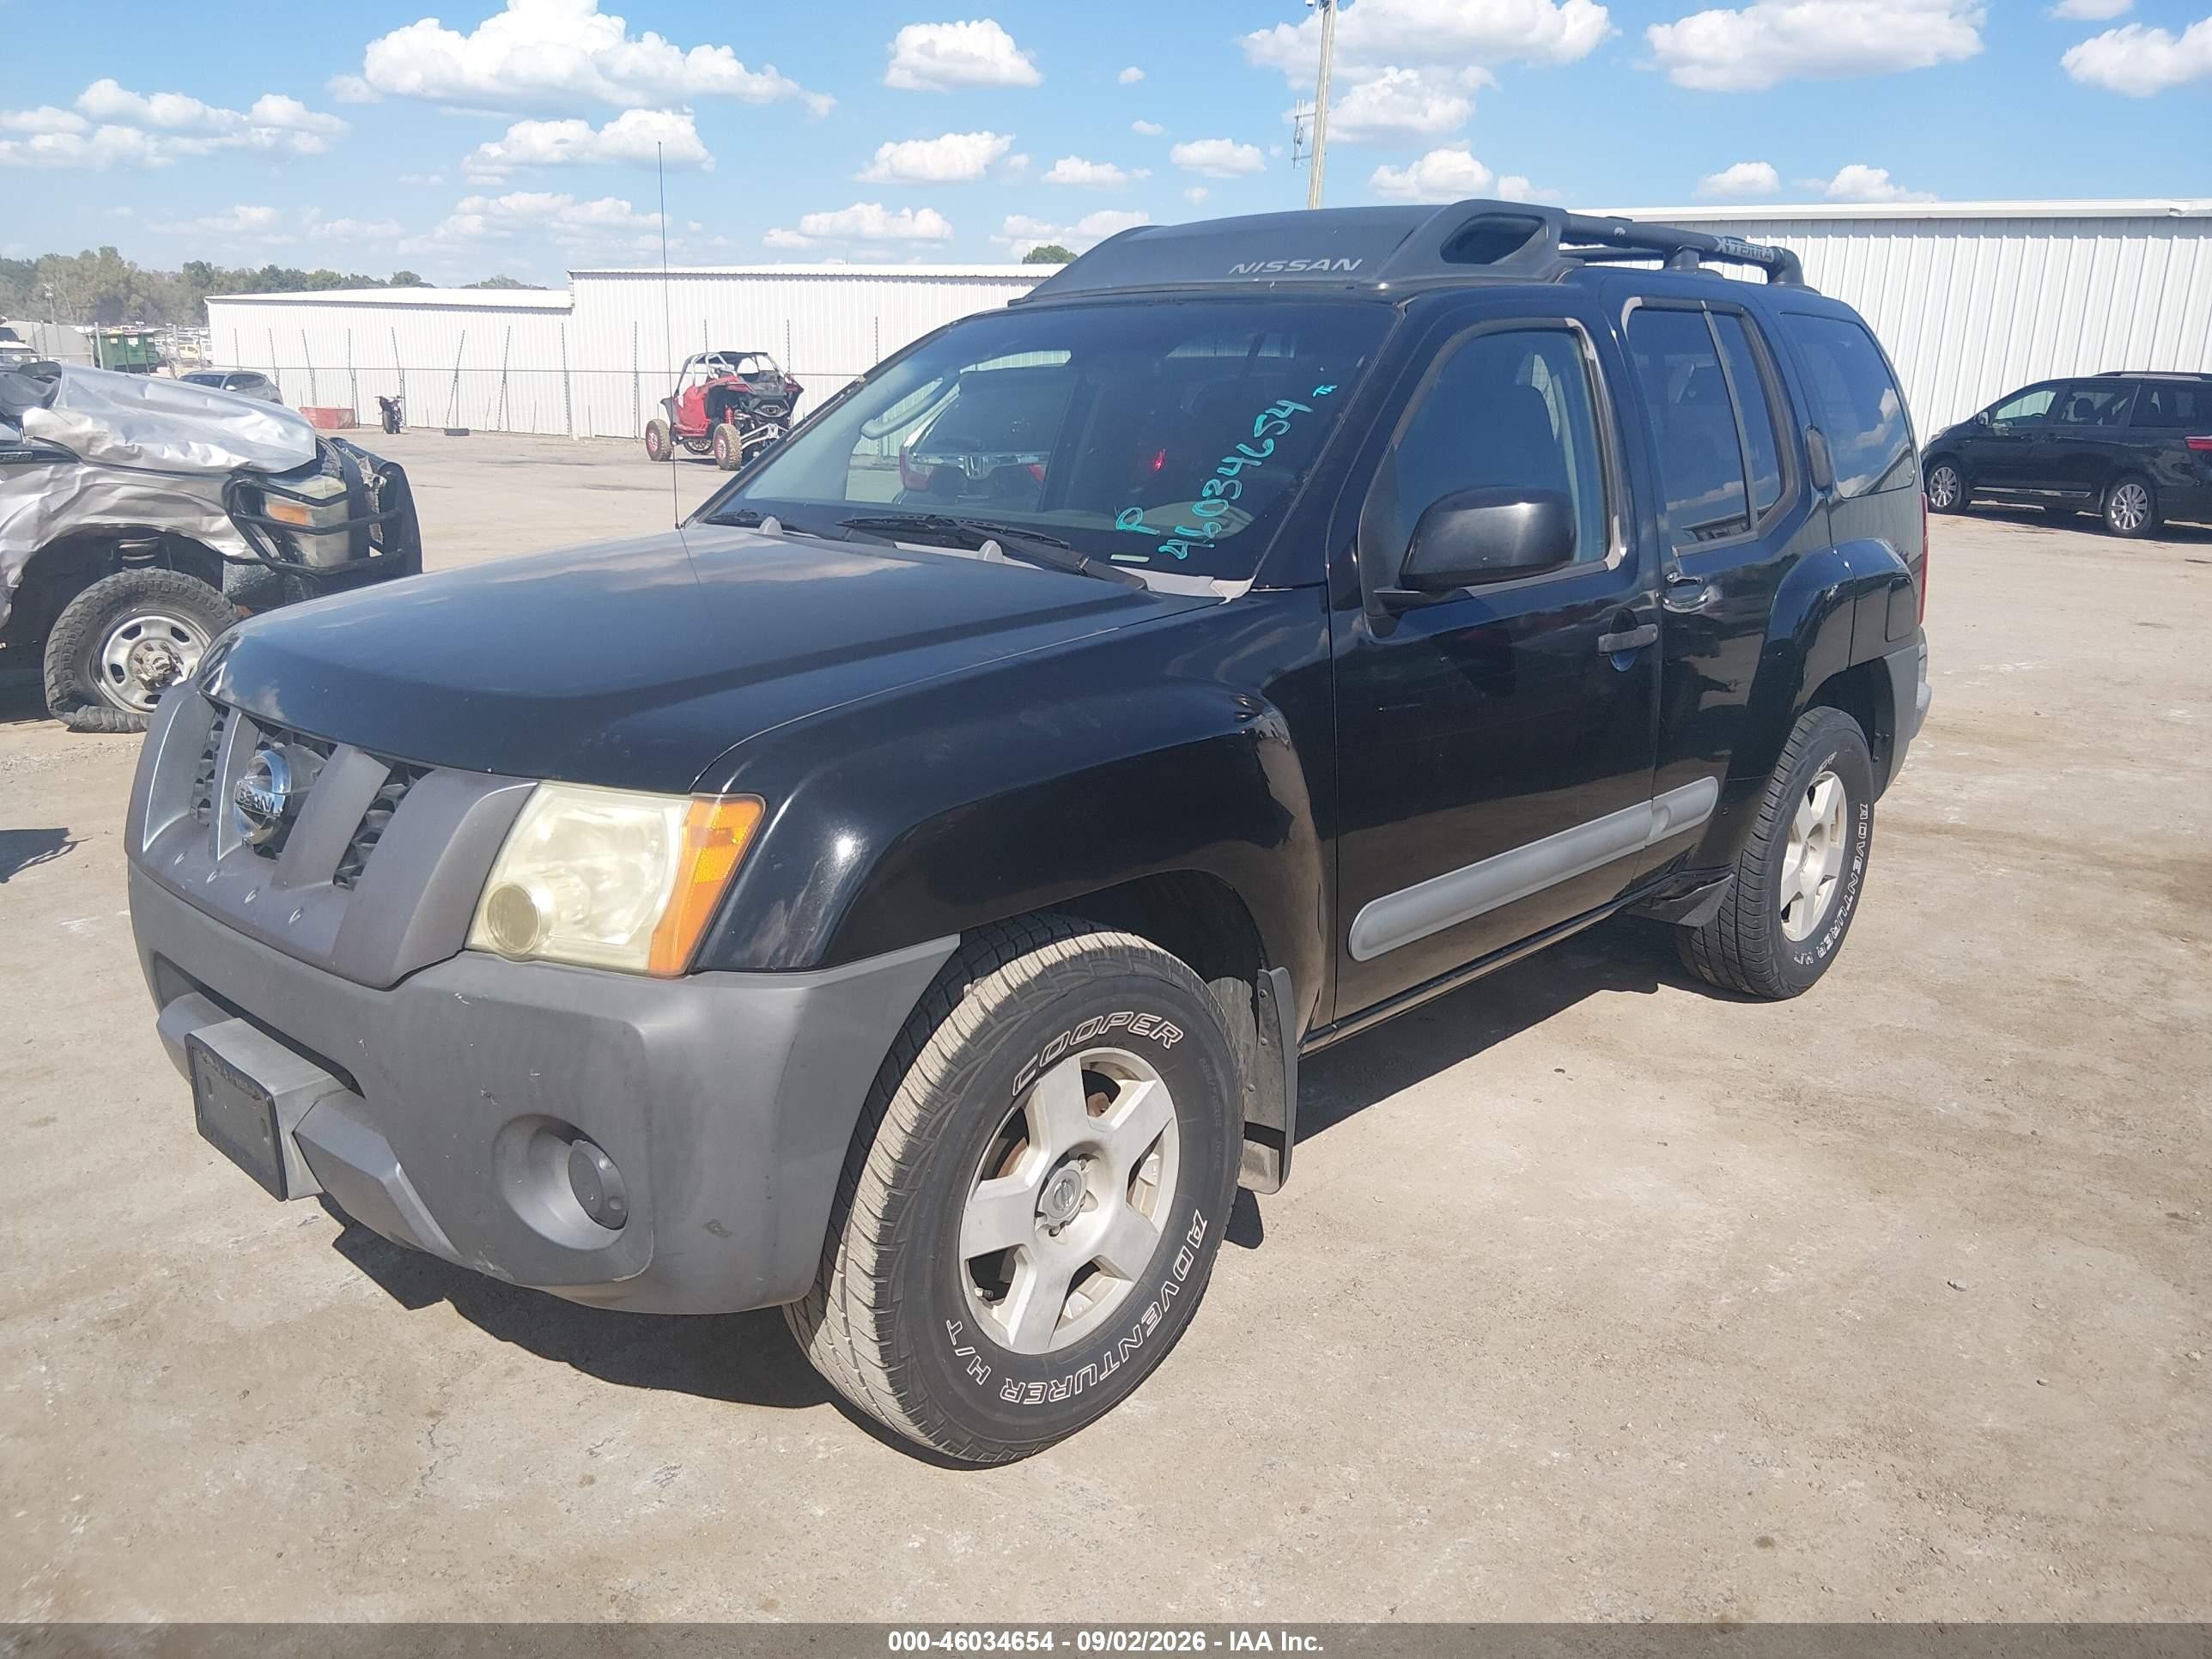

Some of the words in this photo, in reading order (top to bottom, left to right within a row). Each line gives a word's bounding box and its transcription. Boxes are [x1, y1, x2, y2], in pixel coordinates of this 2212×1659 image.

[1229, 258, 1363, 275] NISSAN
[1158, 399, 1314, 560] 46034654
[1012, 1011, 1184, 1097] COOPER
[1000, 1208, 1208, 1406] ADVENTURER
[945, 1319, 992, 1386] H/T
